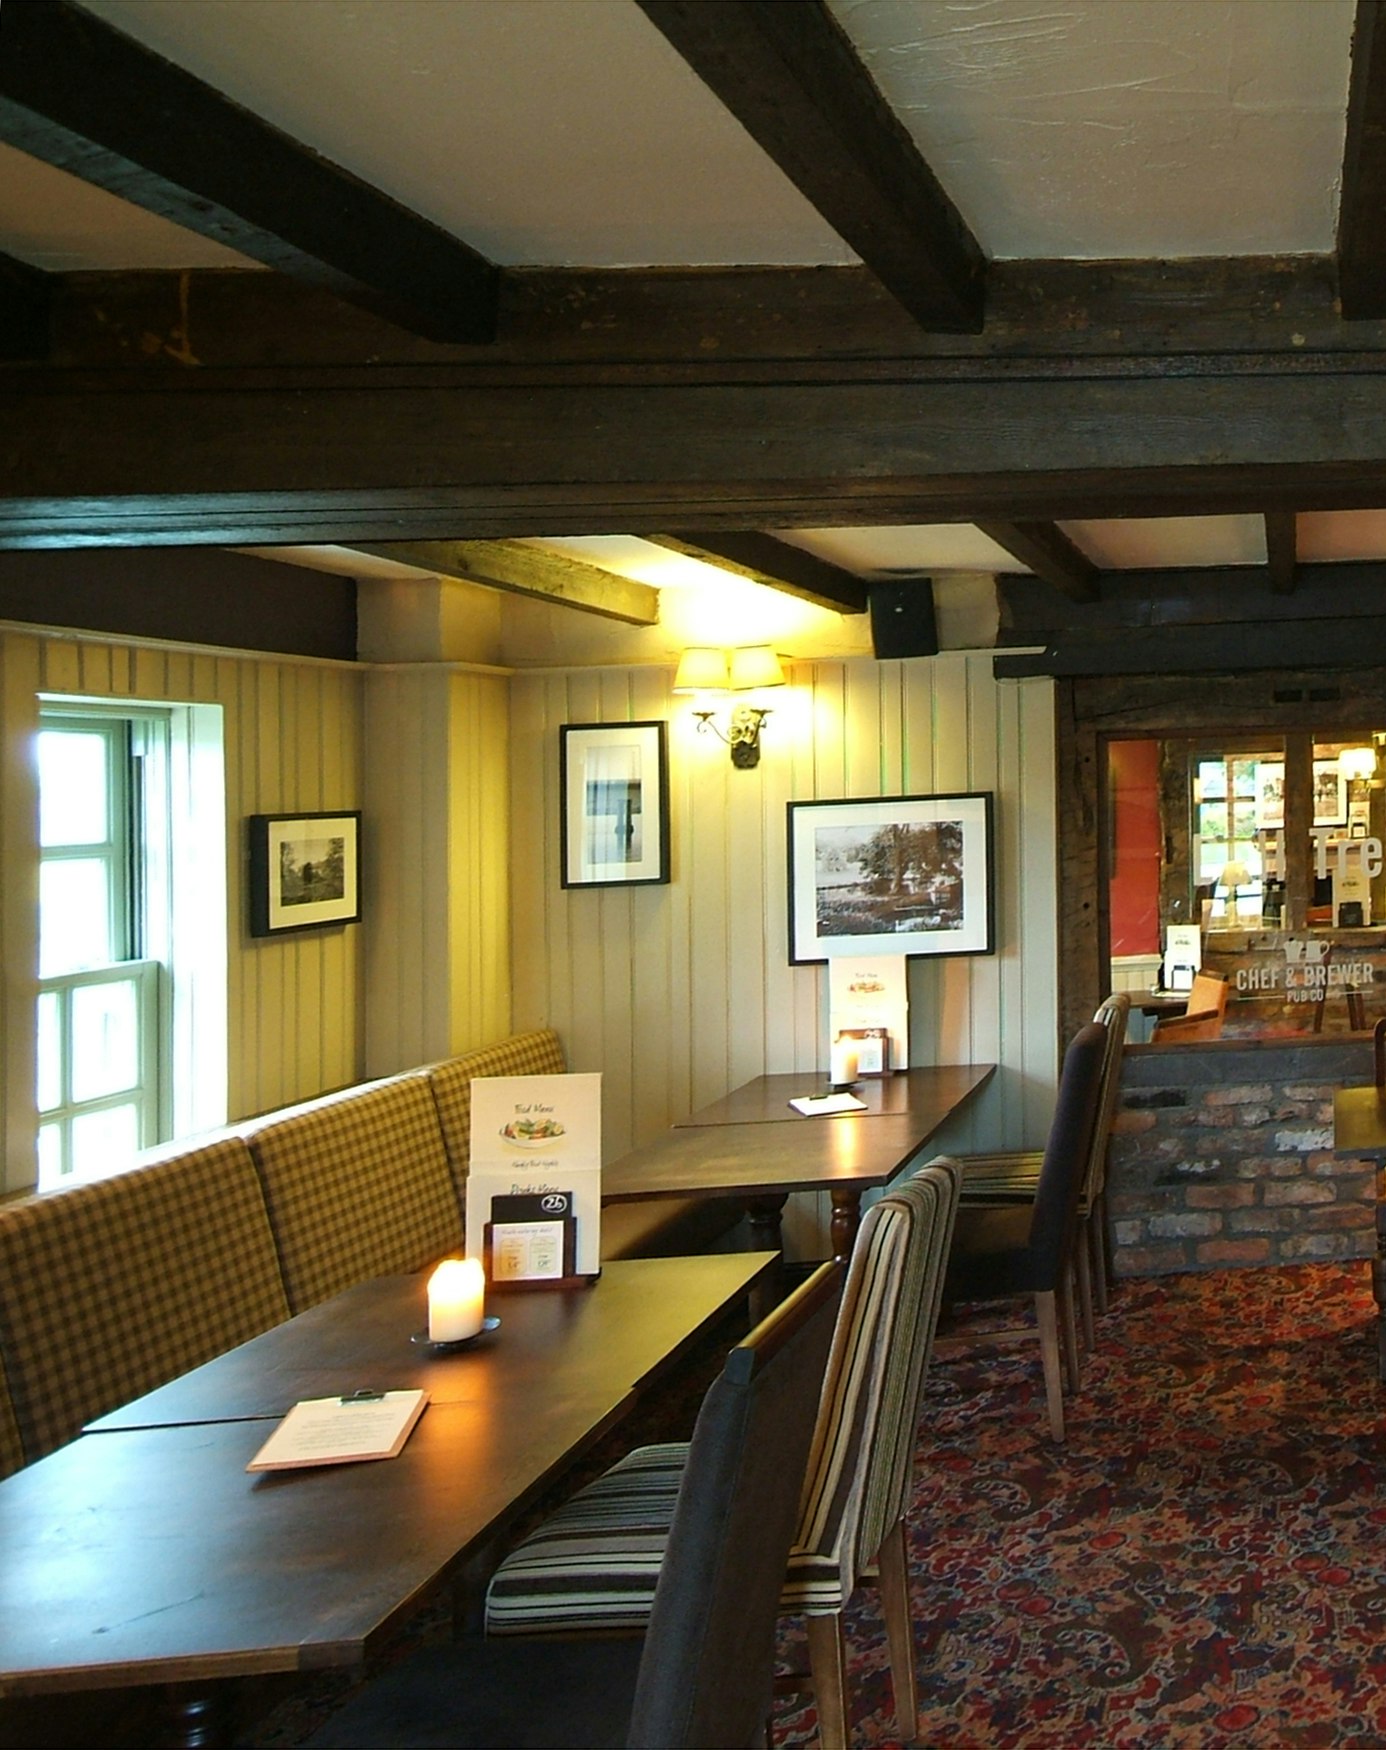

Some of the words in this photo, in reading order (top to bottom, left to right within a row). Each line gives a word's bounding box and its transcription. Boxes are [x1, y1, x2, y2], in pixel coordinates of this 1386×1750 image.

[1236, 967, 1280, 991] CHEF
[1285, 966, 1297, 987] &
[1303, 963, 1374, 986] BREWER
[1287, 990, 1307, 1003] PUB
[1310, 989, 1324, 1001] CO
